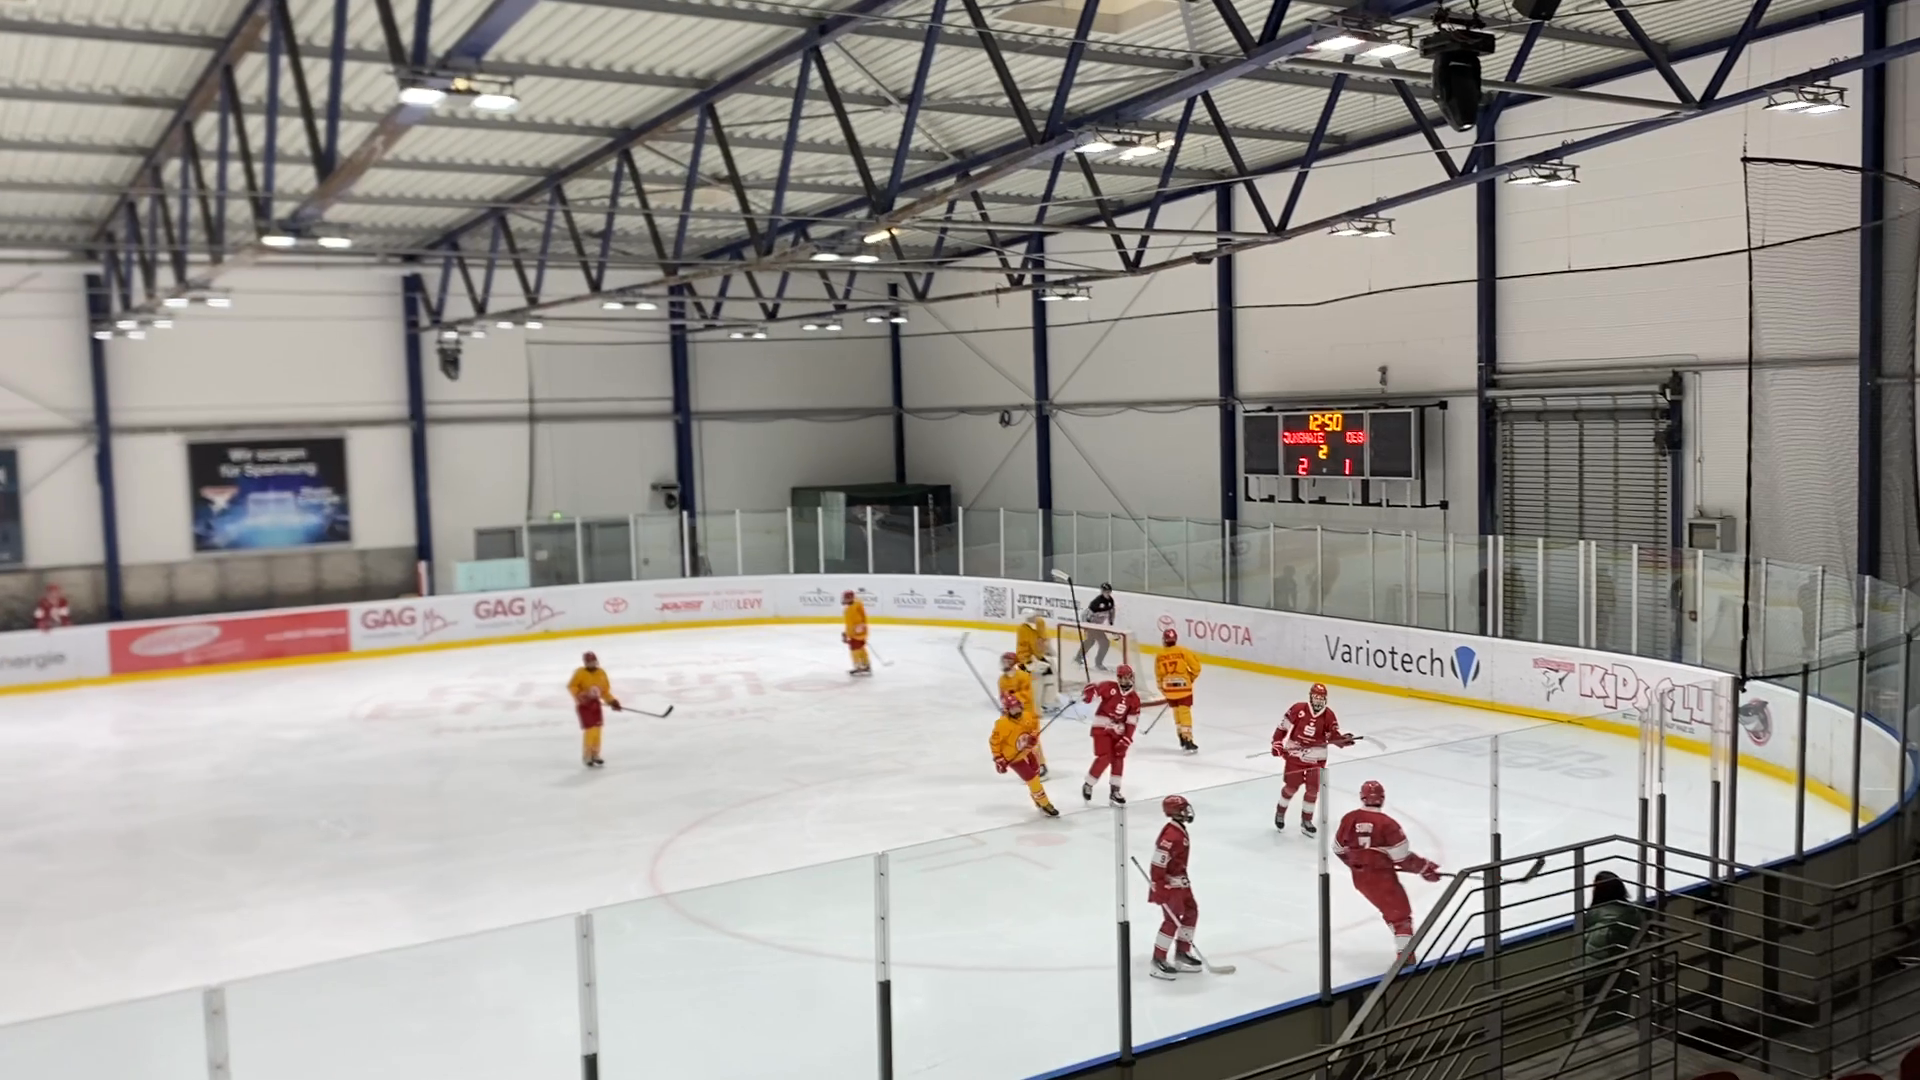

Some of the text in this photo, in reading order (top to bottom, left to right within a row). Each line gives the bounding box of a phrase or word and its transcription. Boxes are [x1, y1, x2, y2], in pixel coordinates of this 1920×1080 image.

[1318, 445, 1328, 459] 2
[1298, 458, 1351, 475] 2 1
[360, 607, 417, 630] GAG
[473, 597, 526, 620] GAG
[1185, 619, 1253, 646] TOYOTA
[1325, 634, 1444, 678] Variotech
